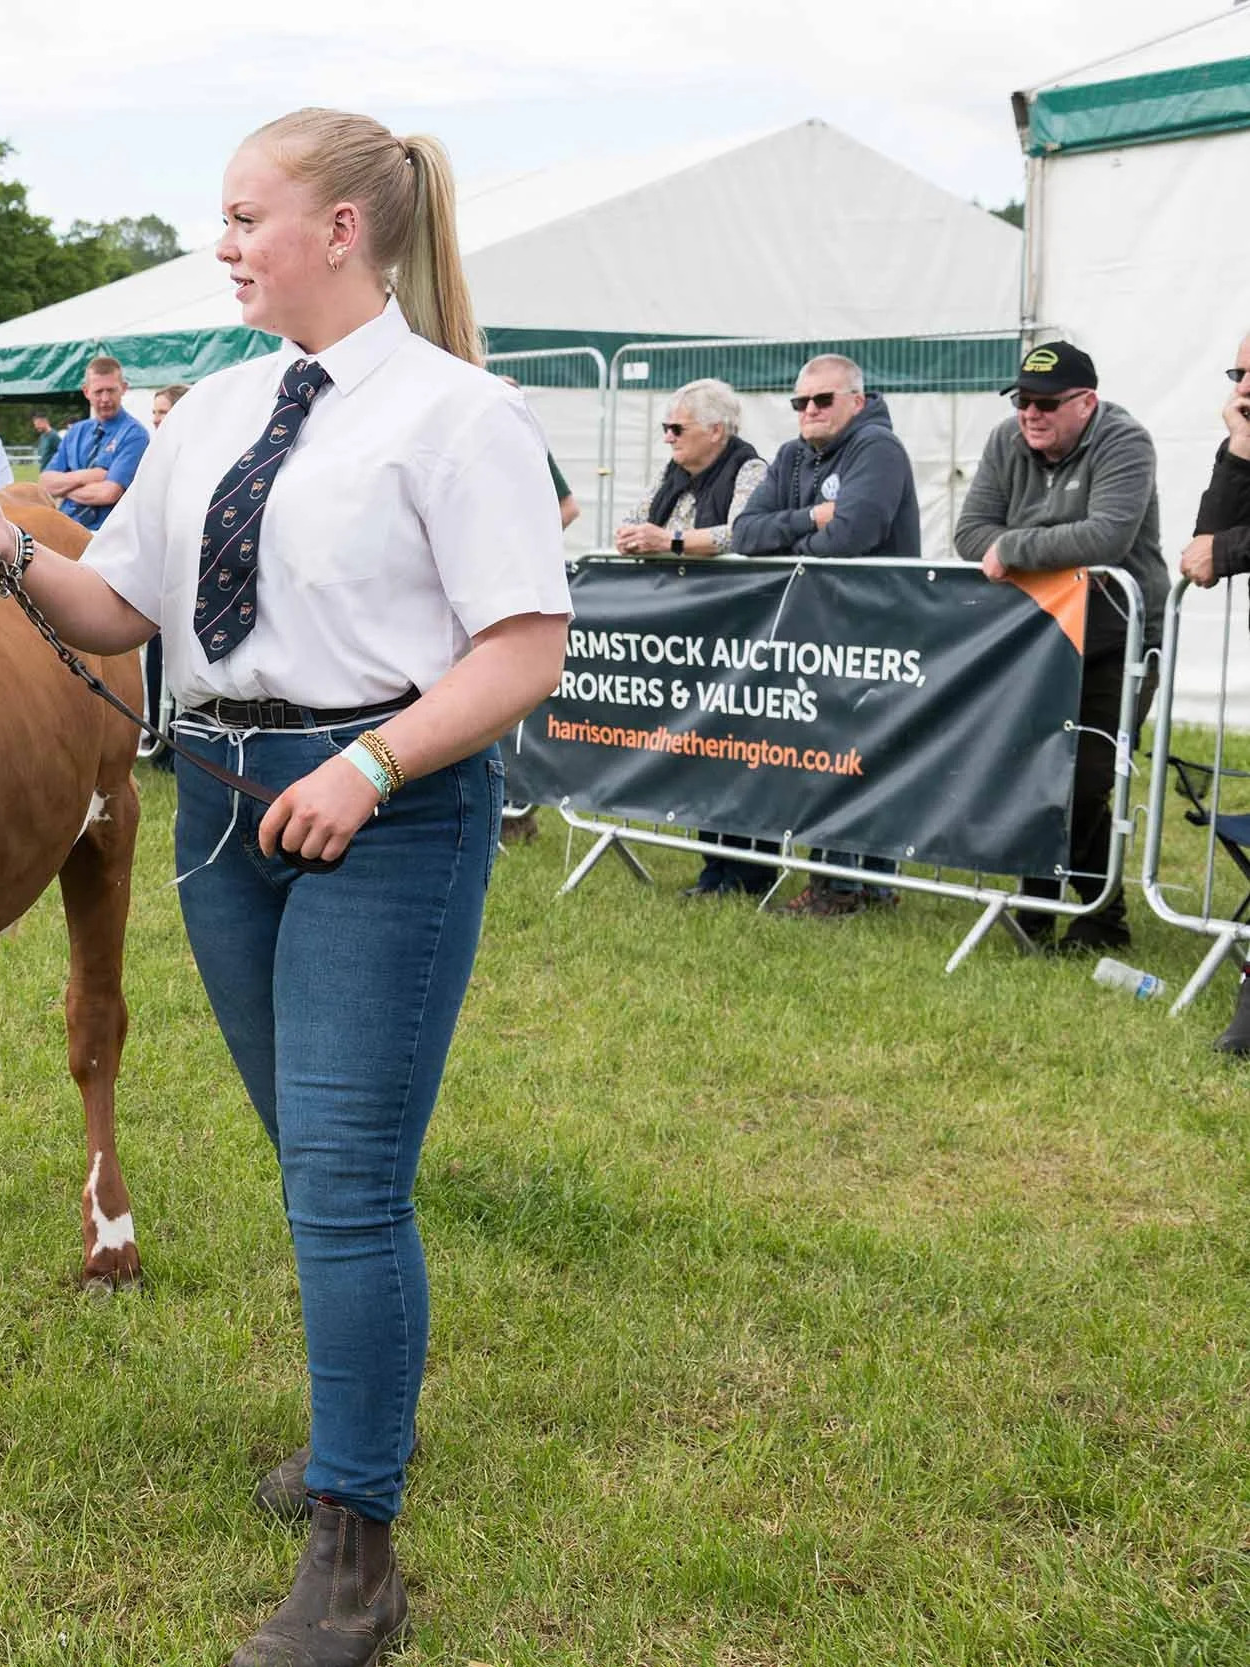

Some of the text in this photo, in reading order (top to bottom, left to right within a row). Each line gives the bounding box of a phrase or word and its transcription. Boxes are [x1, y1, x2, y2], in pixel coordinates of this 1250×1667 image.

[711, 637, 927, 688] AUCTIONEERS,
[550, 670, 819, 722] ROKERS & VALUERS
[547, 712, 864, 776] harrisonandhetherington.co.uk
